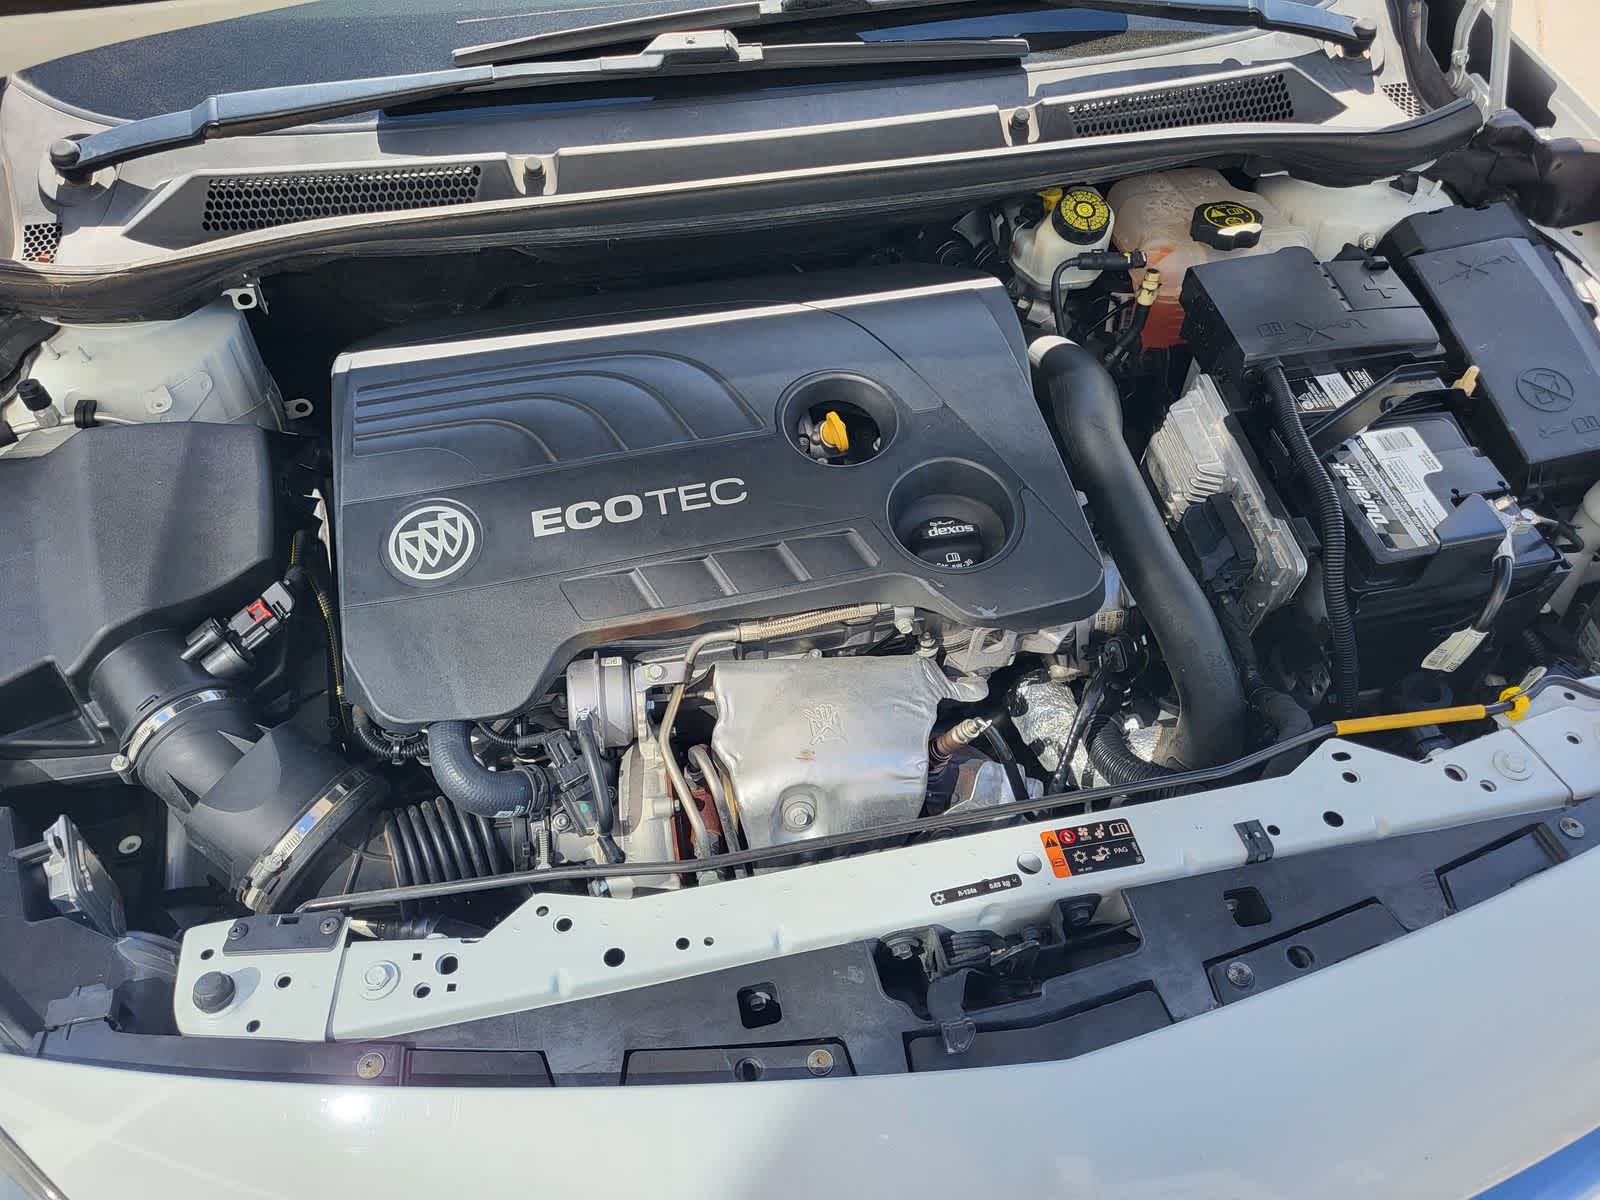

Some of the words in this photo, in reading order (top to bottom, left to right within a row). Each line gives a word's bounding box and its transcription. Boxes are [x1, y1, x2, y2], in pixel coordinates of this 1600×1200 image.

[531, 476, 748, 537] ECOTEC
[1332, 460, 1389, 528] Duralast
[927, 524, 974, 537] dexos
